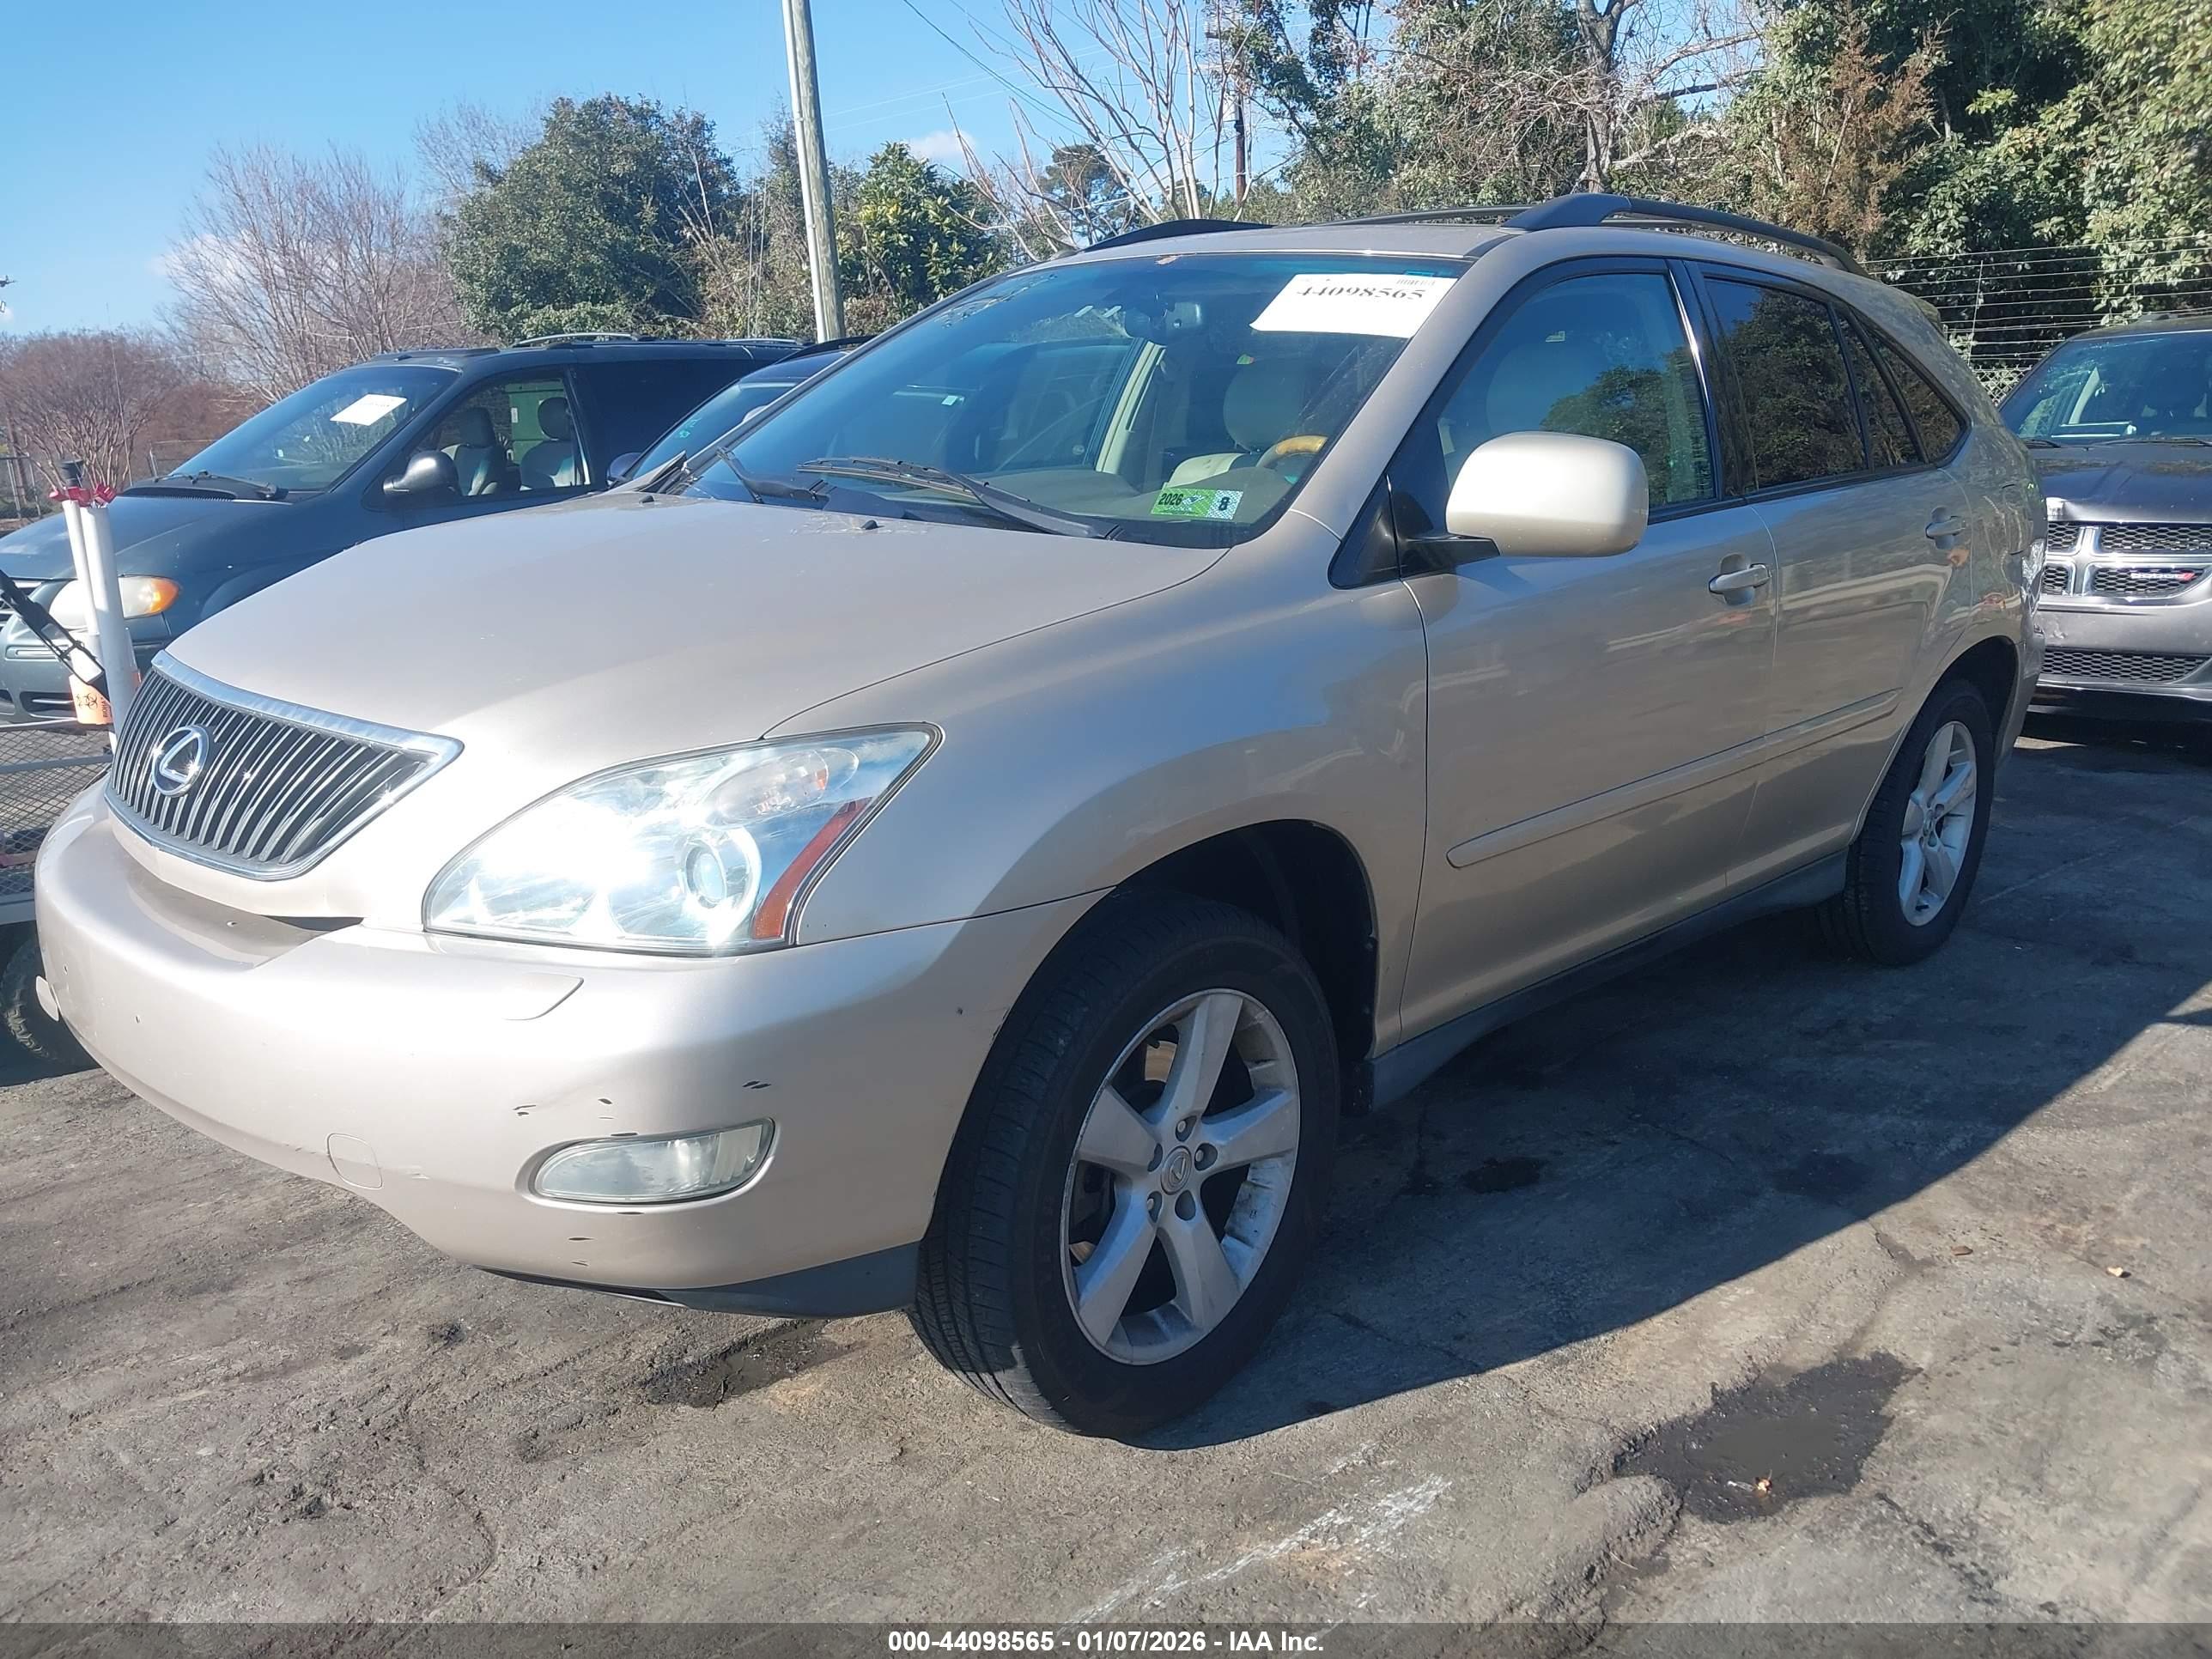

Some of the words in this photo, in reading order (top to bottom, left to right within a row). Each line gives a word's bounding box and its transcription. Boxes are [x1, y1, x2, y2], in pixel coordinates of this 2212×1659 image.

[1296, 286, 1426, 301] 44098565
[1158, 493, 1184, 506] 2026
[1218, 496, 1231, 512] 8
